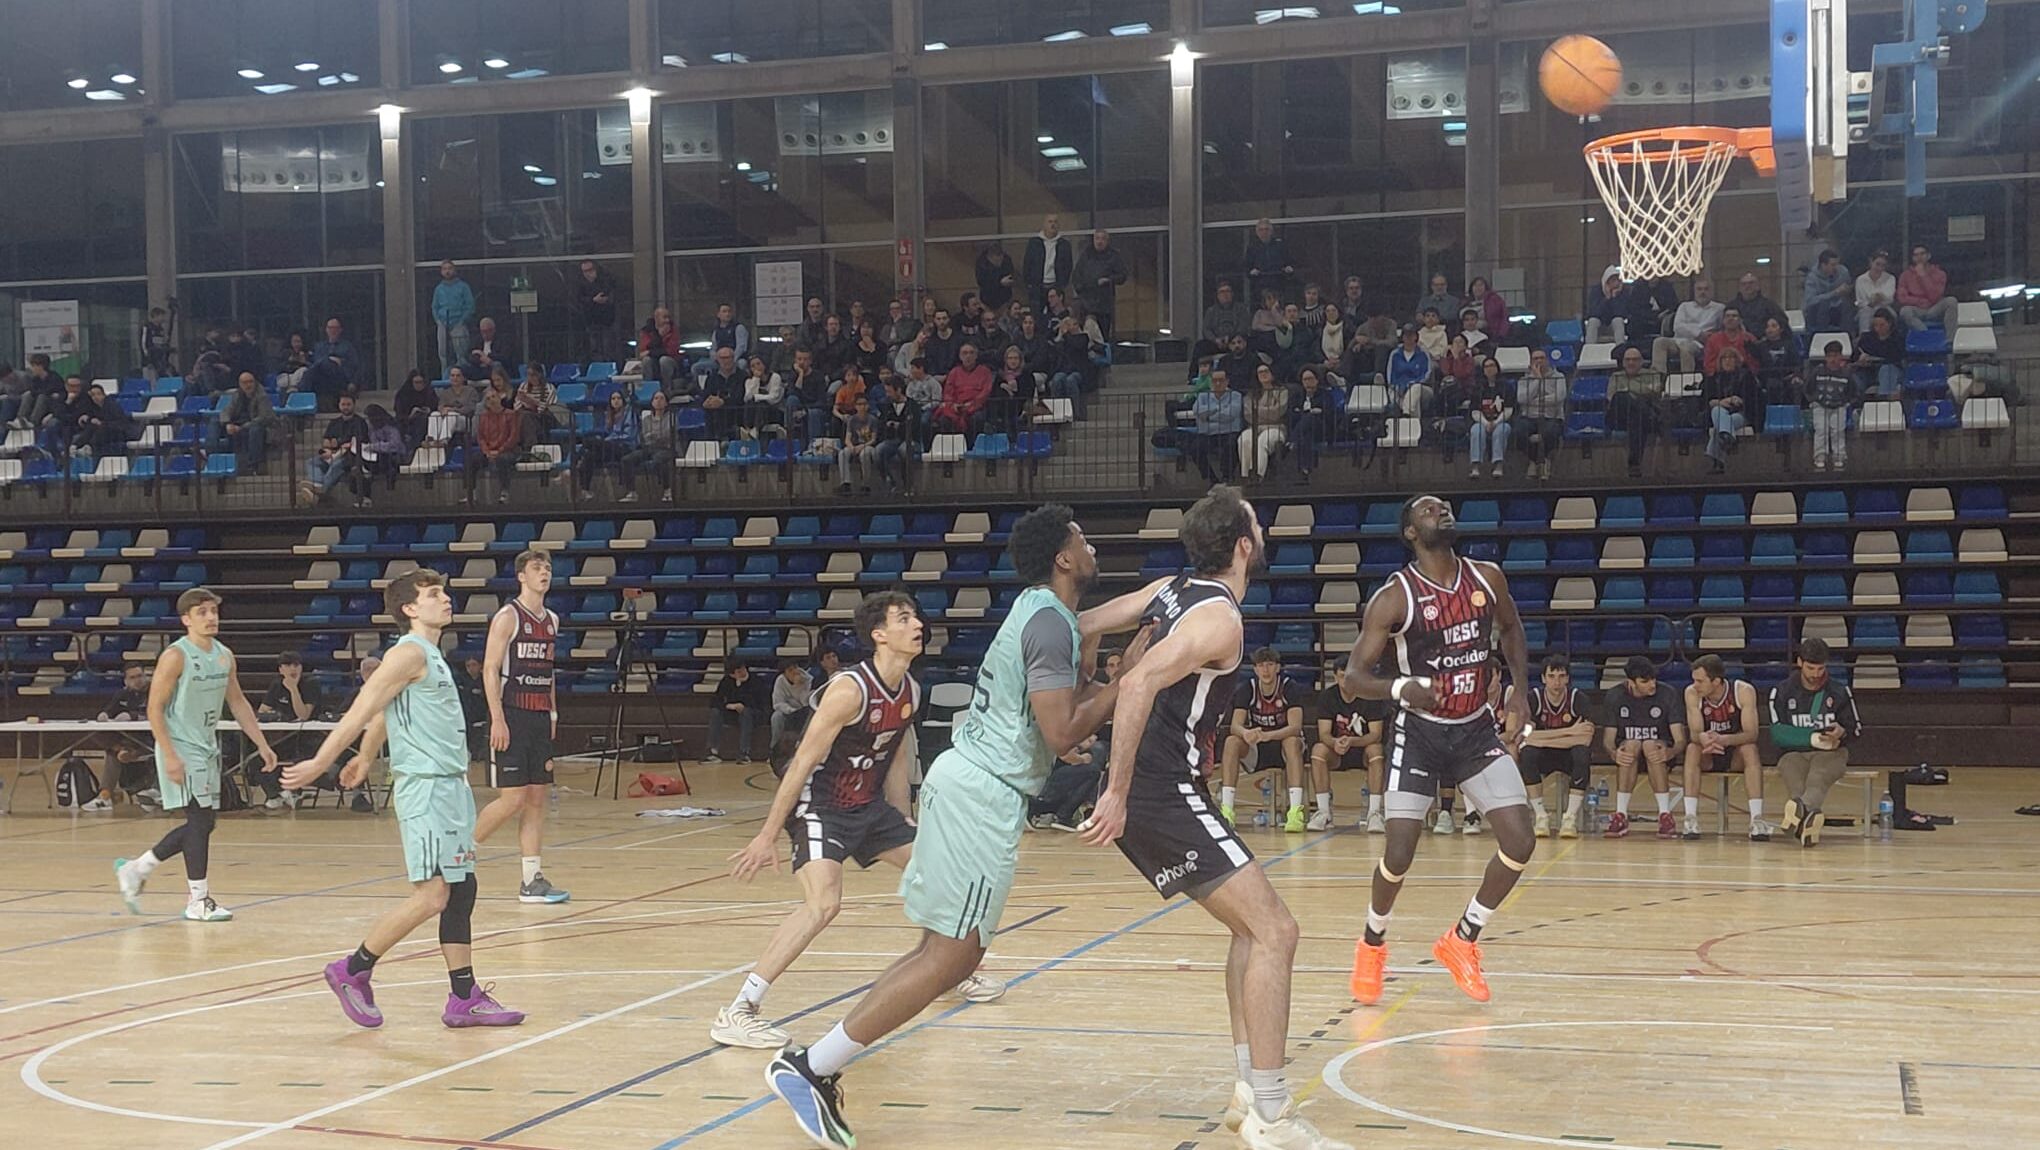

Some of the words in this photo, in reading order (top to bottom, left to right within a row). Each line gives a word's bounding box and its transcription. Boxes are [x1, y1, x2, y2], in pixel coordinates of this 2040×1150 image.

[517, 642, 547, 659] UESC
[1453, 672, 1476, 695] 55
[1625, 726, 1658, 740] UESC
